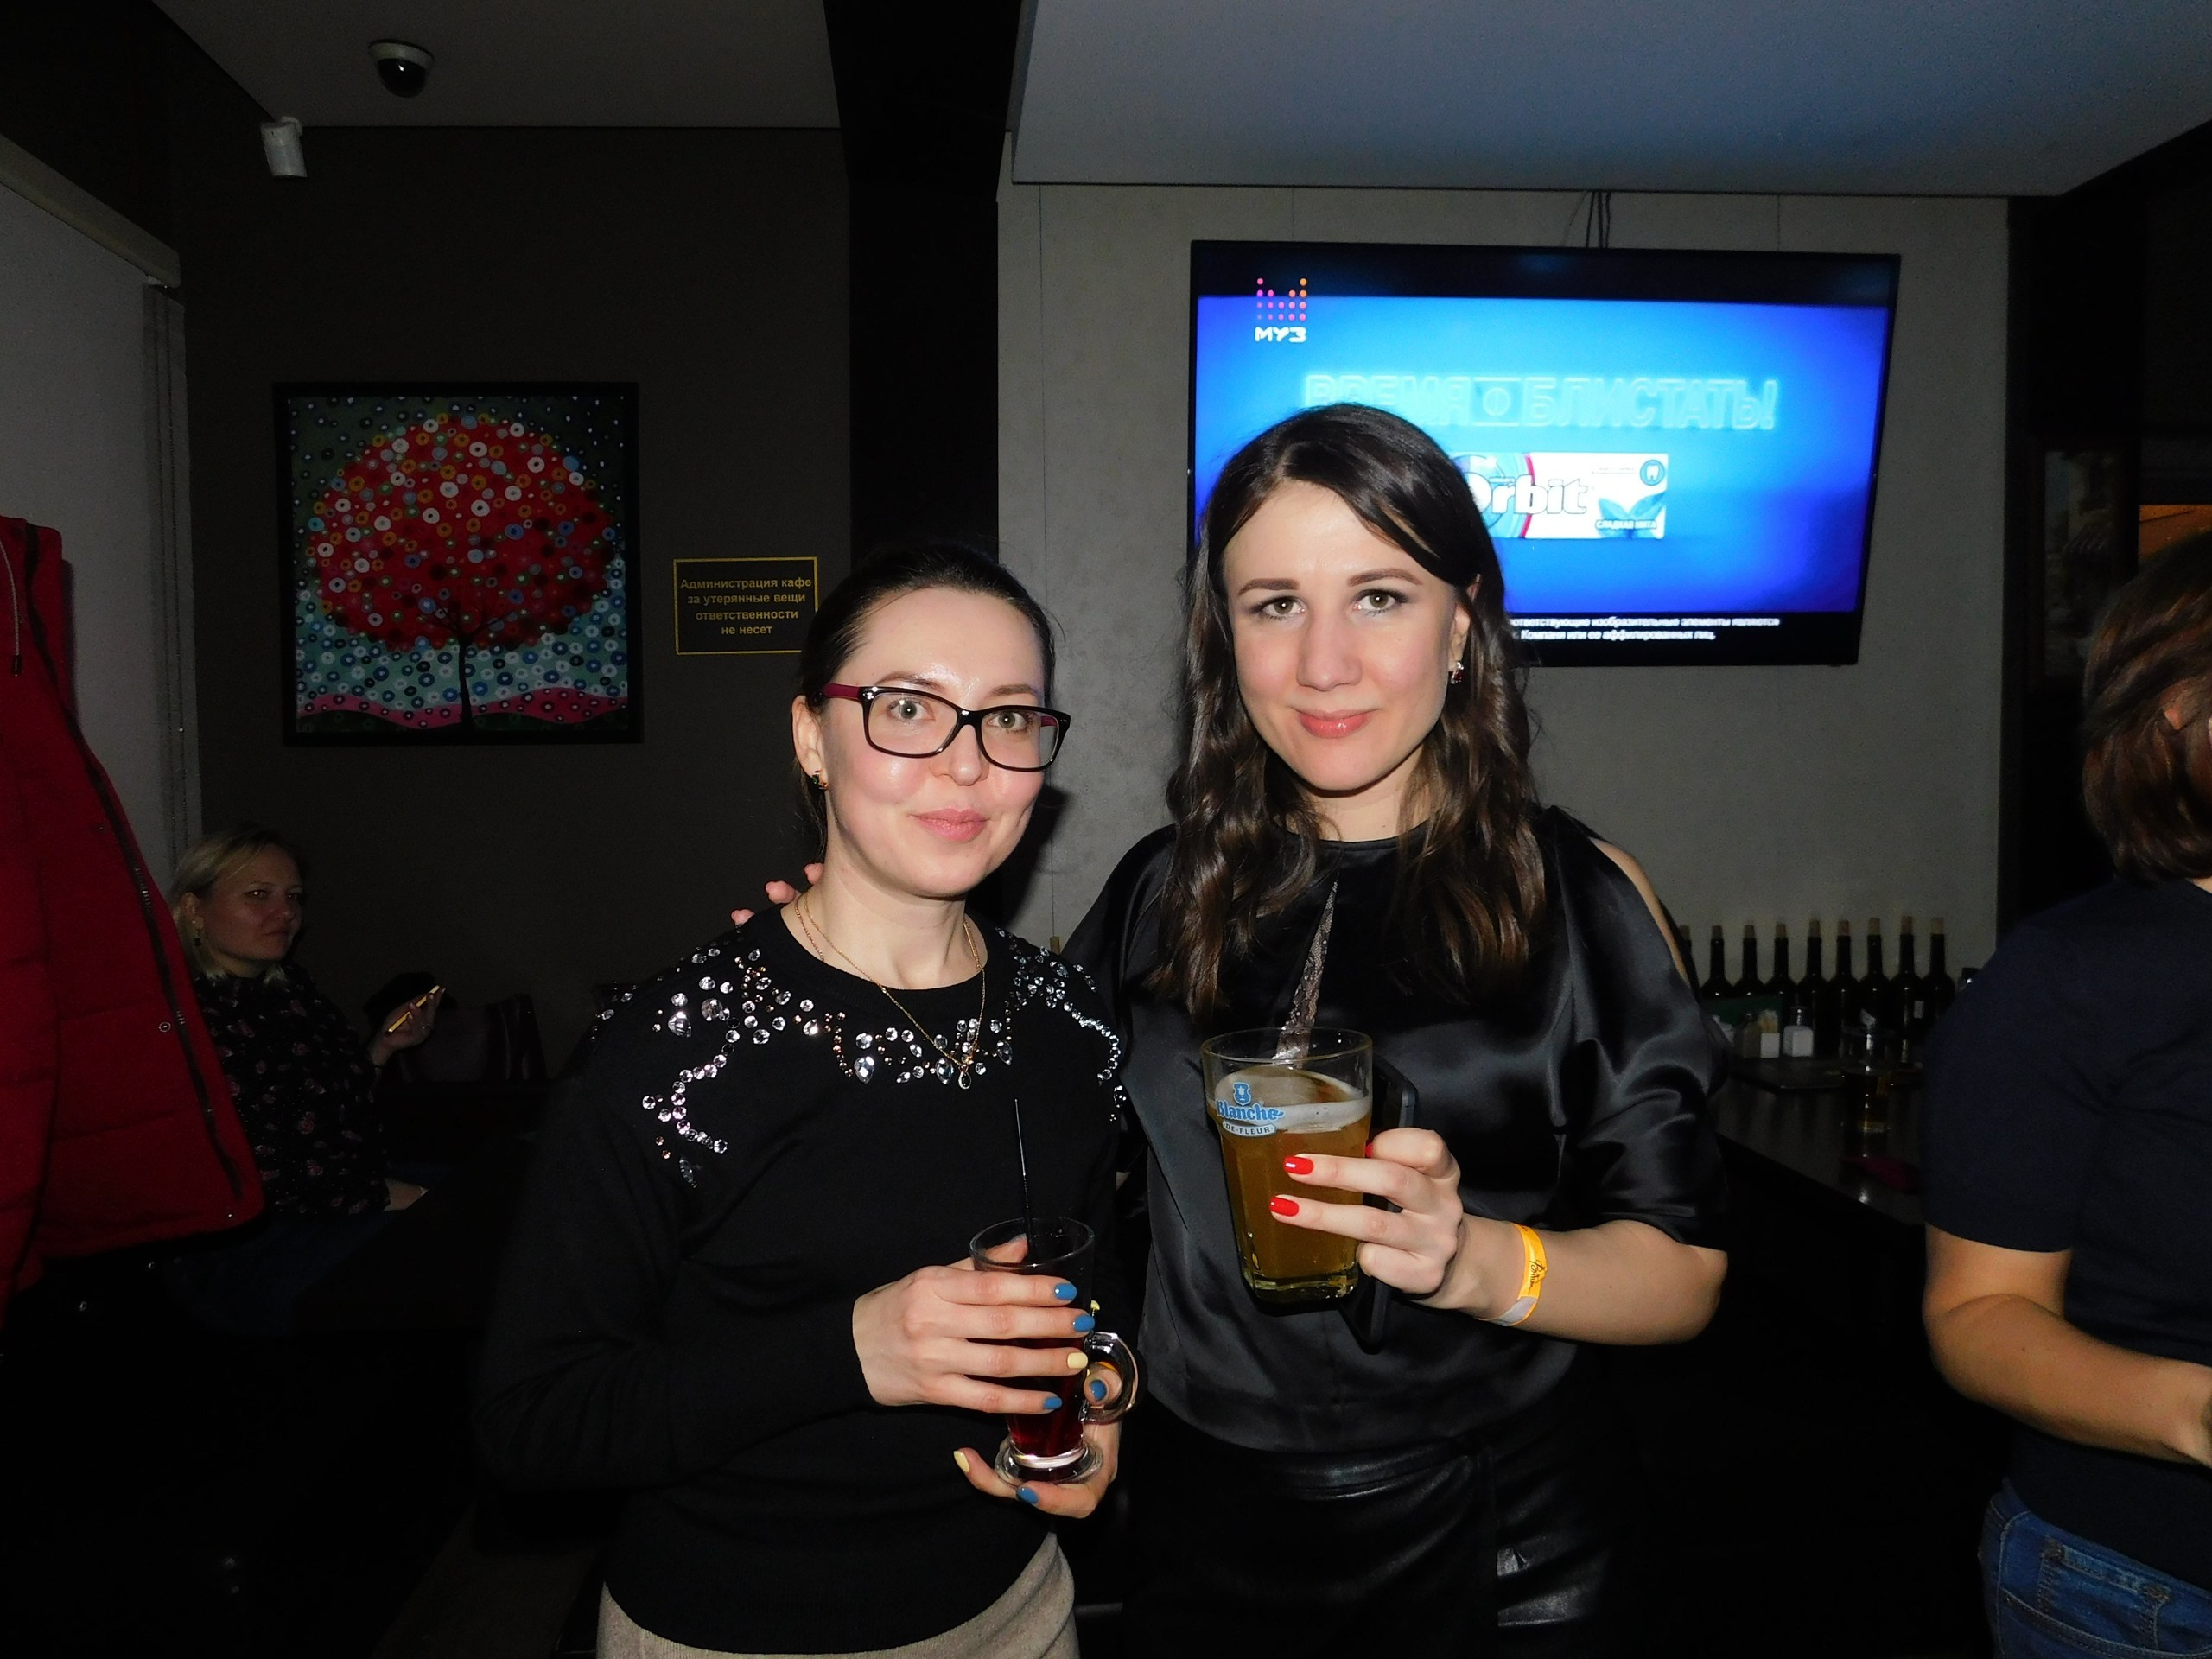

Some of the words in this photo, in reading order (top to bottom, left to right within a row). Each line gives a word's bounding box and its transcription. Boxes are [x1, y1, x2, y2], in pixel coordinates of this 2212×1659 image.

[1255, 326, 1306, 343] МУЗ
[680, 578, 778, 591] Администрация
[781, 576, 811, 590] кафе
[687, 594, 700, 604] за
[703, 594, 770, 607] утерянные
[773, 593, 806, 604] вещи
[695, 609, 799, 621] ответственности
[721, 626, 736, 635] не
[739, 625, 773, 635] несет
[1216, 1099, 1285, 1121] Blanche
